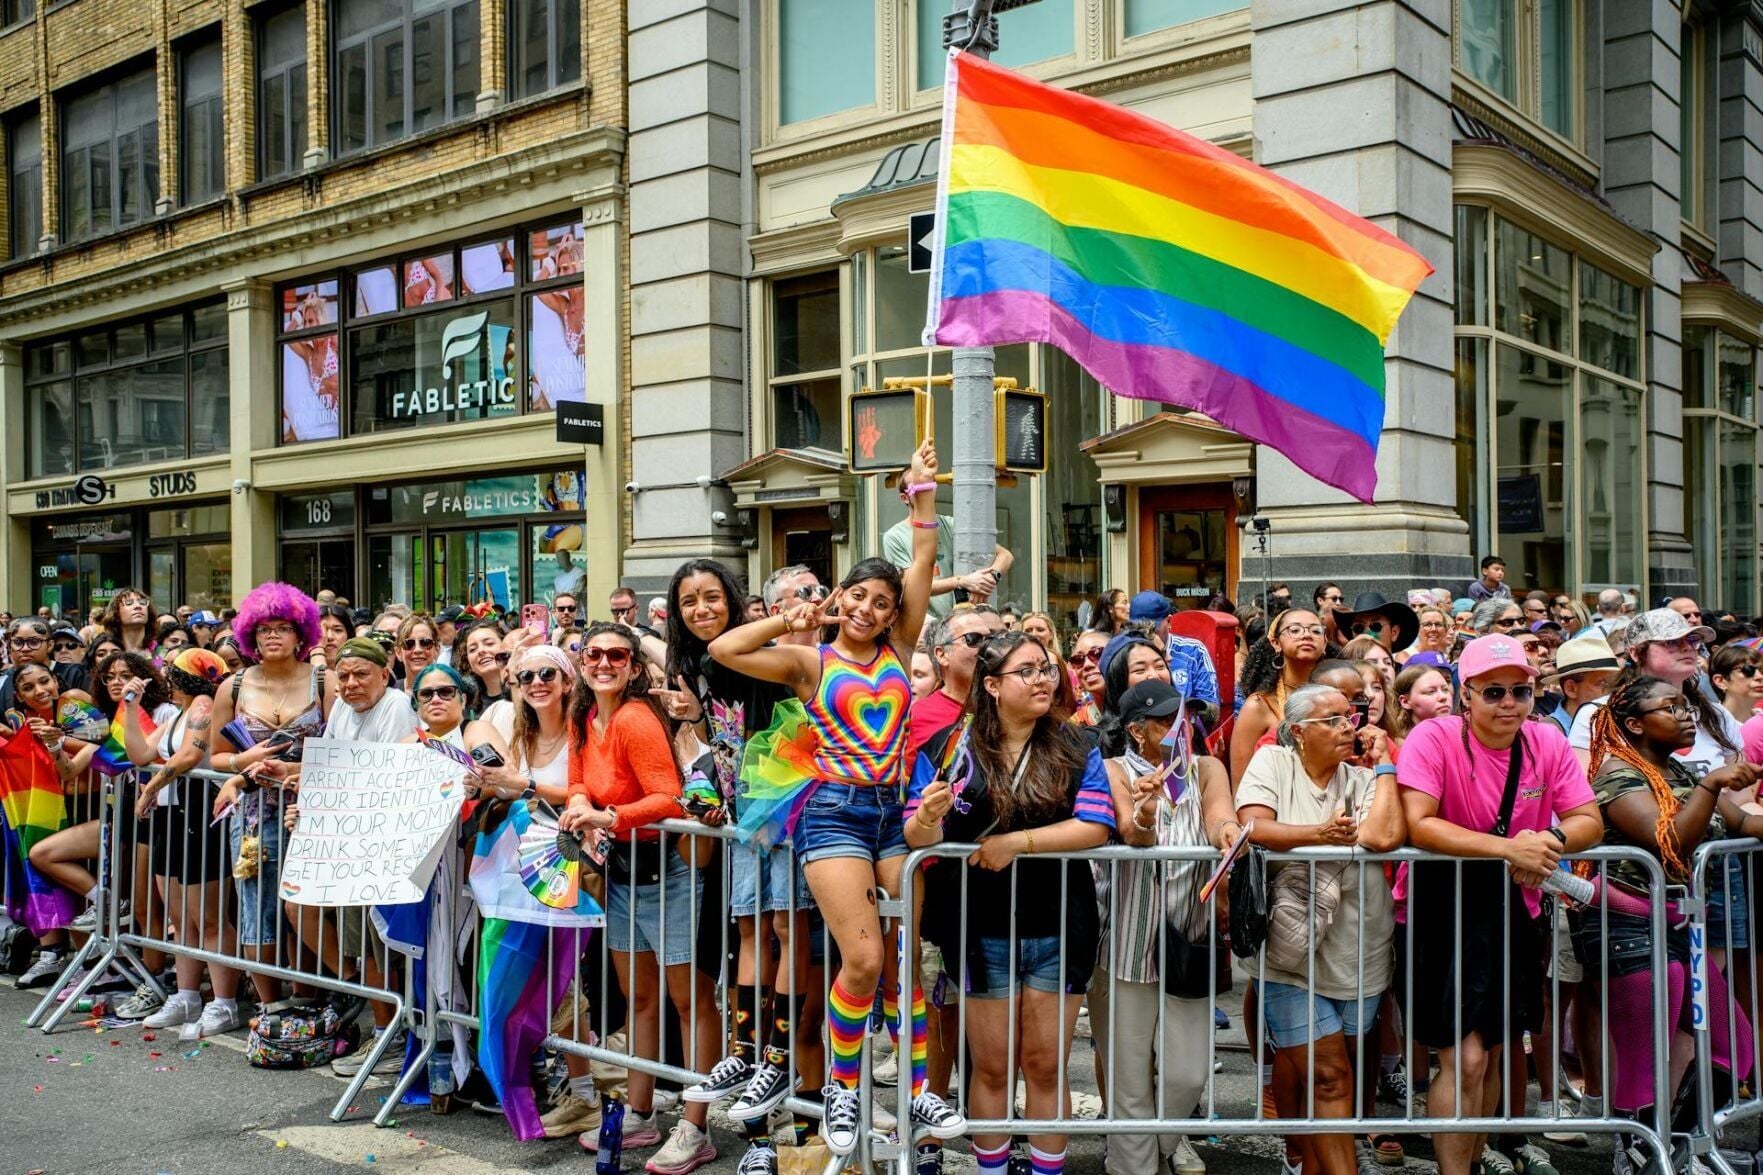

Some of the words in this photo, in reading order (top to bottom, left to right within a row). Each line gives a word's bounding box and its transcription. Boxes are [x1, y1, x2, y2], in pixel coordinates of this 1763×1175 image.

[393, 377, 533, 417] FABLETIC
[564, 417, 602, 428] FABLETICS
[150, 471, 196, 497] STUDS
[306, 500, 331, 524] 168
[442, 490, 530, 513] FABLETICS
[40, 565, 58, 578] OPEN
[1176, 587, 1190, 597] BUCK
[1191, 587, 1210, 597] MASON
[304, 746, 340, 766] IF
[350, 747, 395, 769] YOUR
[303, 770, 362, 789] AREN'T
[366, 765, 446, 790] ACCEPTING
[301, 791, 350, 809] YOUR
[356, 785, 434, 808] IDENTITY
[334, 812, 386, 835] YOUR
[290, 837, 350, 859] DRINK
[356, 838, 406, 859] SOME
[284, 860, 326, 880] GET
[330, 860, 376, 880] YOUR
[315, 885, 336, 903] I
[349, 880, 400, 903] LOVE
[1689, 927, 1704, 1025] NYPD
